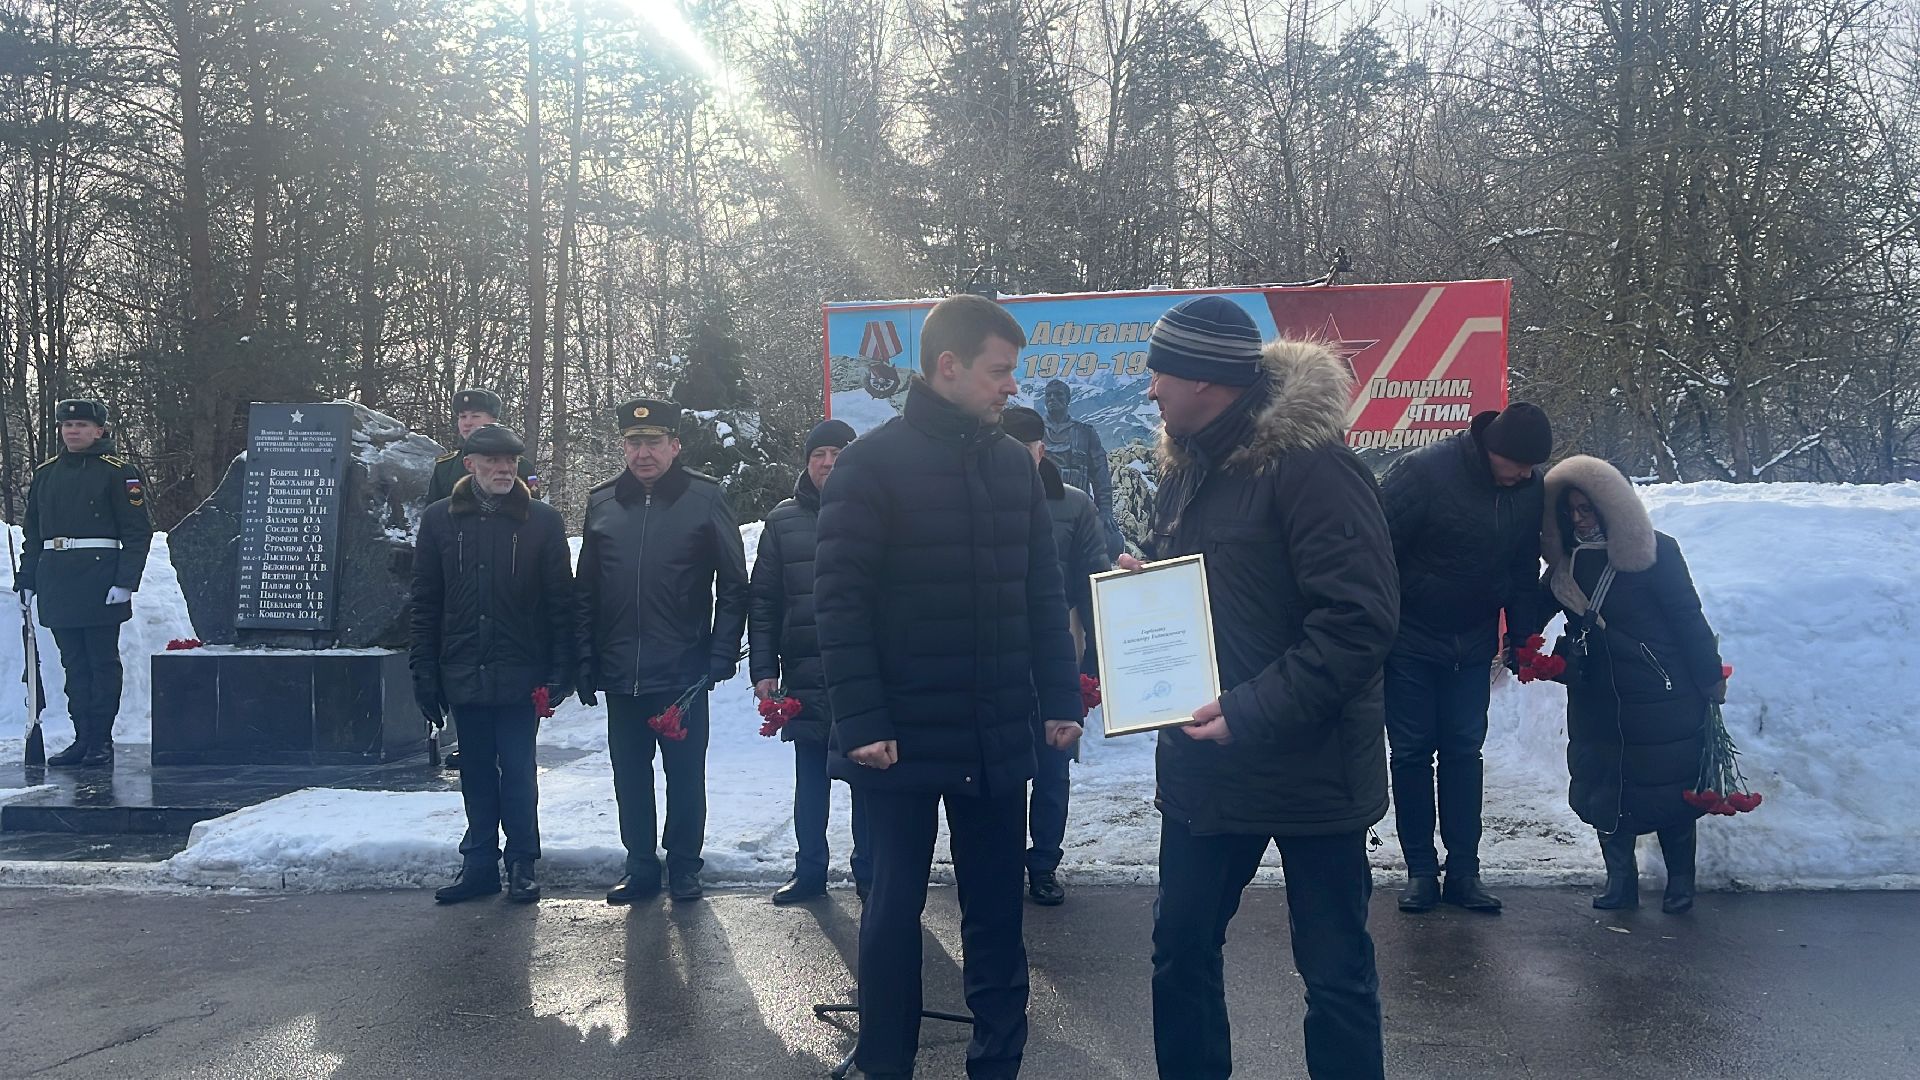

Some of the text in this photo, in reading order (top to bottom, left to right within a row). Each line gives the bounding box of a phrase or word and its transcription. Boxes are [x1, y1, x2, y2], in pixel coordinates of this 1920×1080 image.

[1029, 321, 1154, 346] Афгани
[1024, 351, 1150, 378] 1979-19
[1370, 378, 1472, 399] Помним,
[1408, 403, 1472, 422] чтим,
[1348, 428, 1467, 450] гордимс
